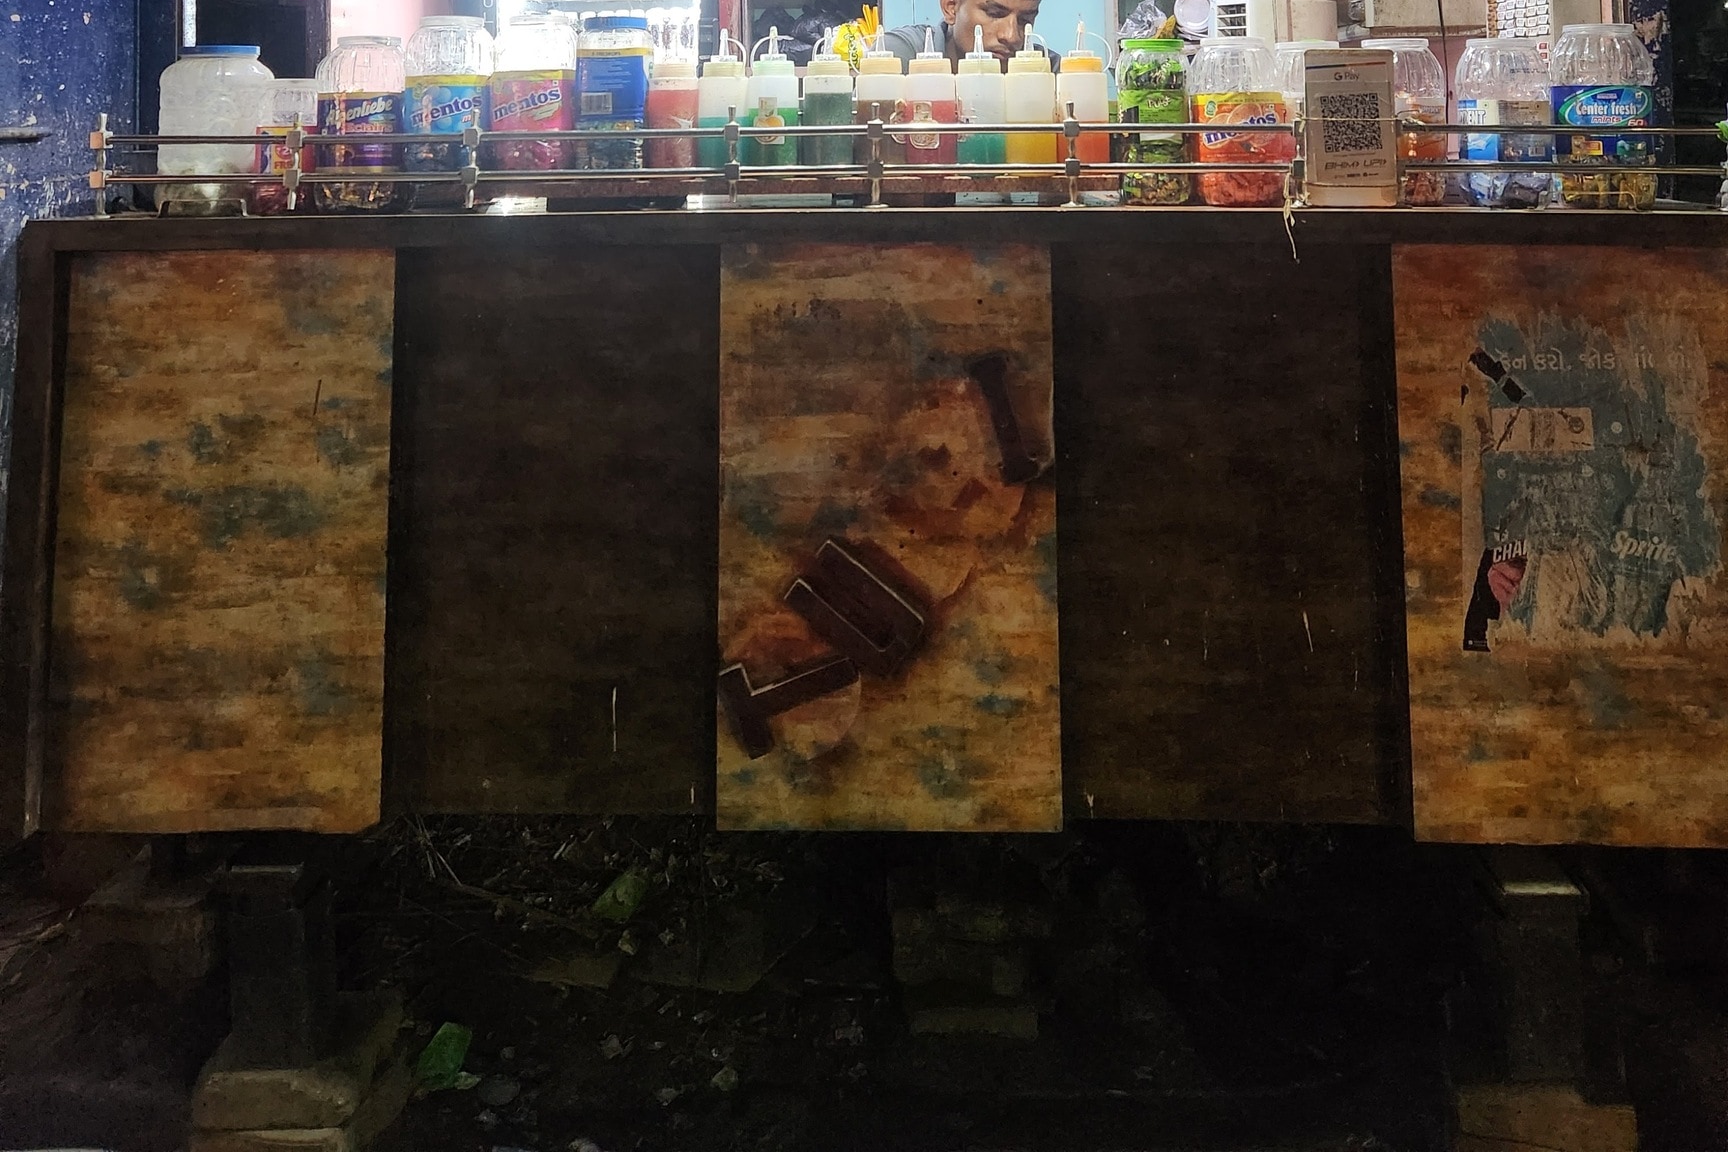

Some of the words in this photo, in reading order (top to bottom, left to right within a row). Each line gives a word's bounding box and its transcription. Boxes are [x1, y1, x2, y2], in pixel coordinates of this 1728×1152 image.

[410, 94, 482, 126] mentos
[493, 87, 562, 122] mentos
[1575, 101, 1608, 116] Center
[1610, 100, 1637, 115] fresh
